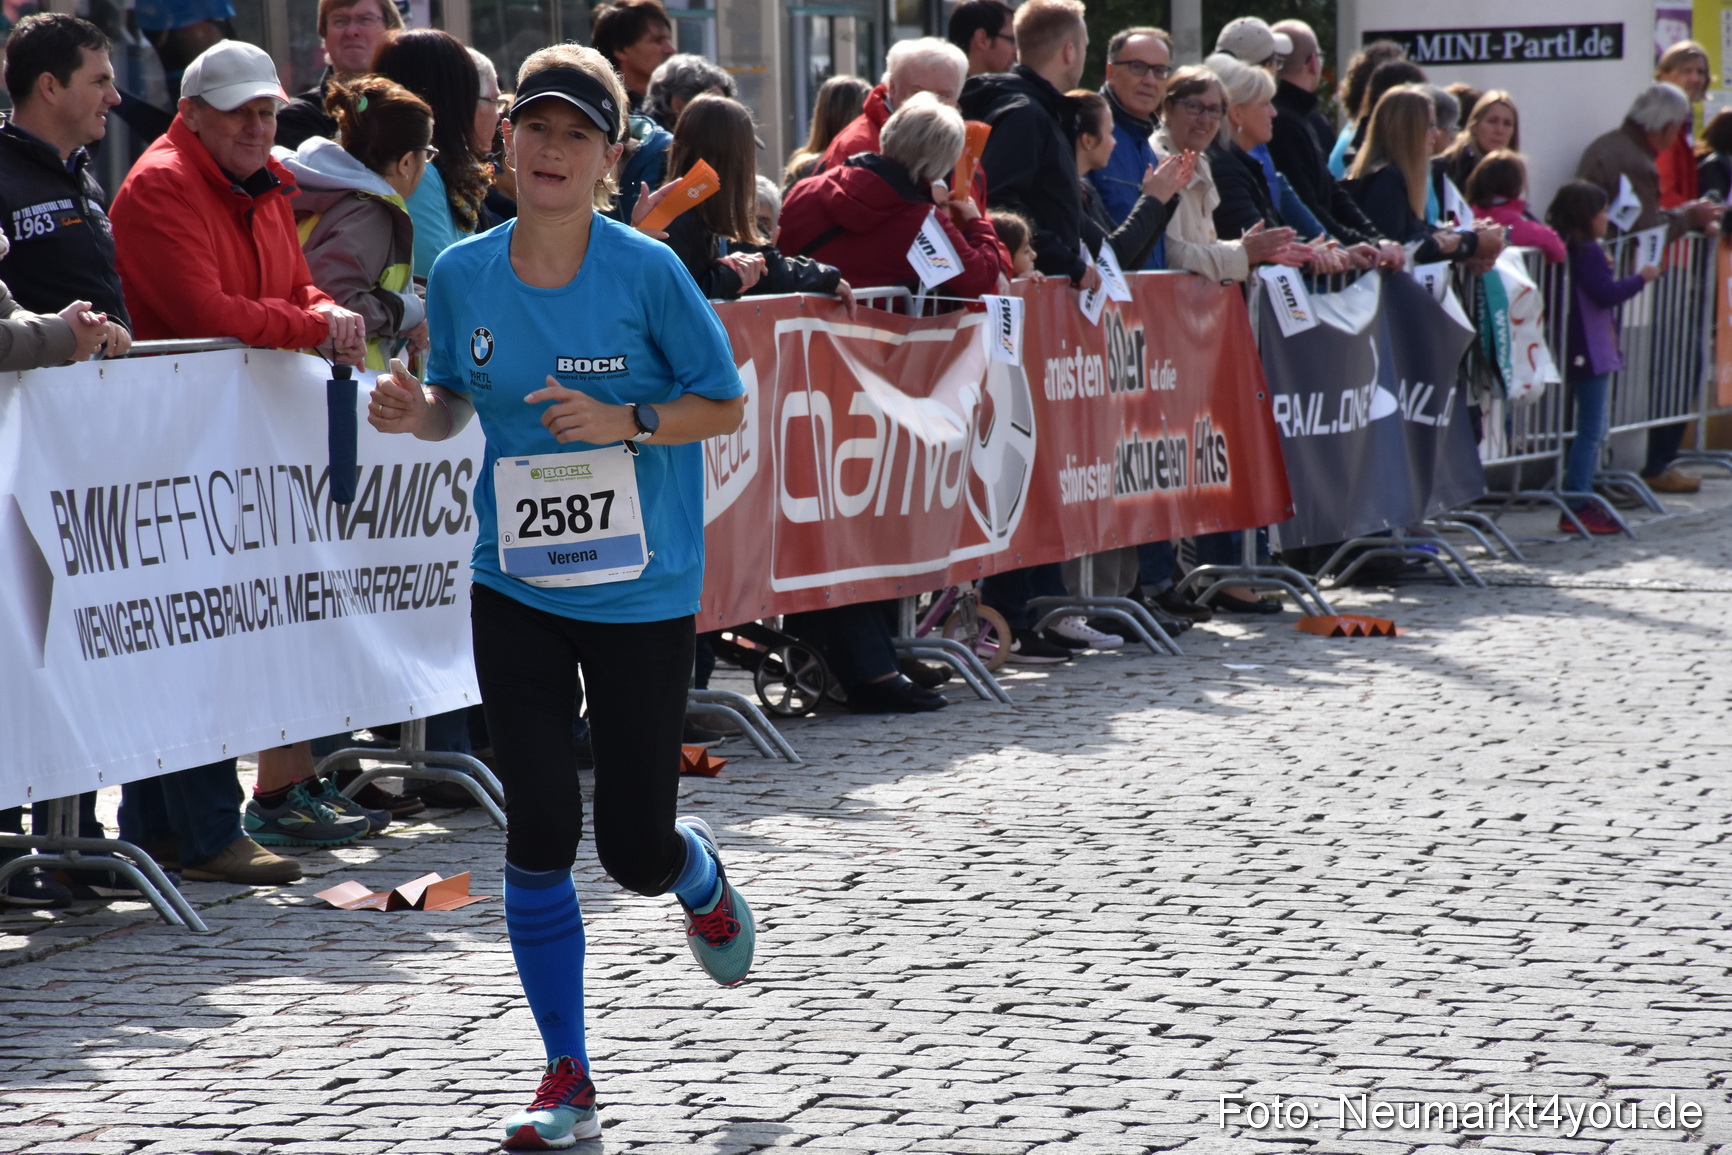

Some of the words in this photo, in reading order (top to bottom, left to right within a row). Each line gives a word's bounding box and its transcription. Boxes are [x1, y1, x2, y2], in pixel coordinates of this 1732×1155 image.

[14, 213, 55, 241] 1963
[556, 354, 628, 374] BOCK
[1193, 415, 1230, 486] Hits
[543, 464, 592, 479] BOCK
[50, 483, 131, 577] BMW
[516, 489, 615, 539] 2587
[547, 549, 598, 566] Verena
[73, 598, 160, 661] WENIGER
[154, 577, 284, 647] VERBRAUCH.
